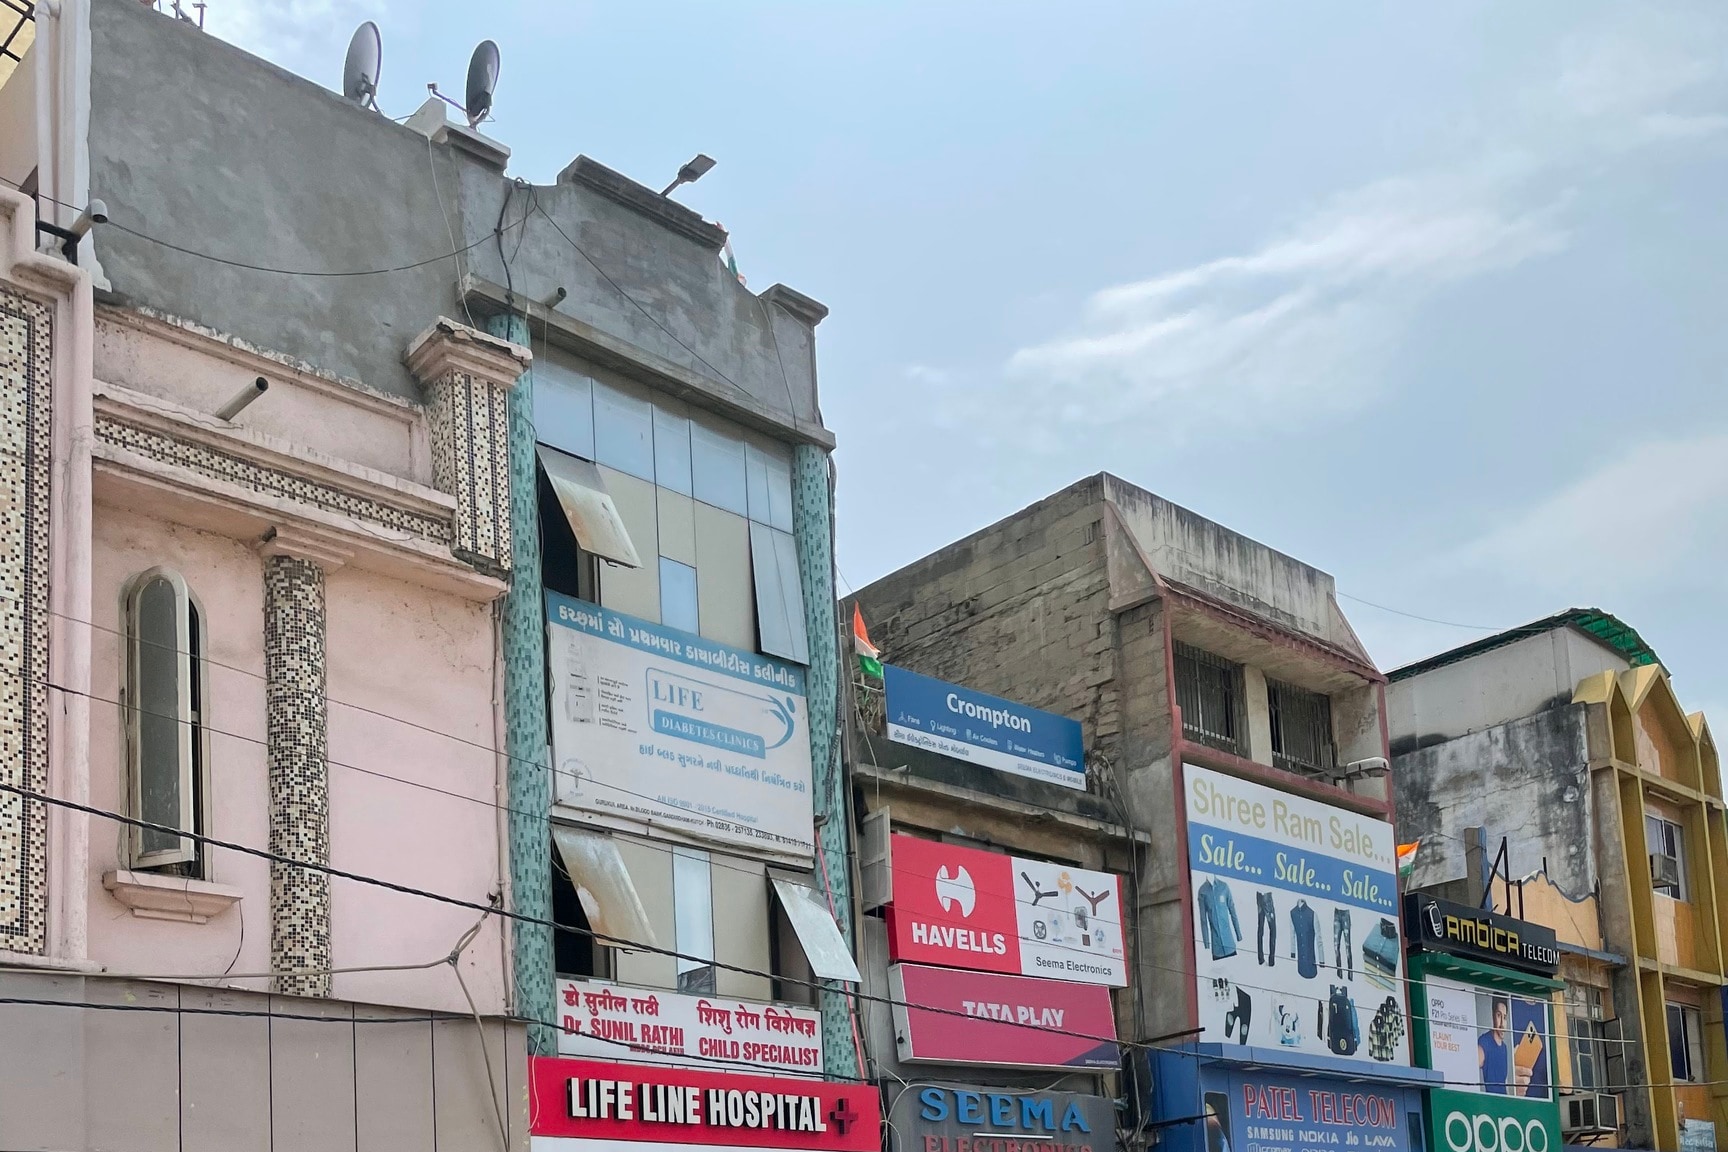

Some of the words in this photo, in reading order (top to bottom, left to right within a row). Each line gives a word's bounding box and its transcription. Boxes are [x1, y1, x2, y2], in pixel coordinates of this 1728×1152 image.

[653, 679, 704, 712] LIFE
[907, 714, 921, 725] Fans
[936, 722, 957, 736] Lighting
[946, 692, 1032, 734] Crompton
[661, 716, 716, 740] DIABETES
[717, 731, 760, 751] CLINICS
[1192, 777, 1266, 830] Shree
[1272, 798, 1323, 846] Ram
[1198, 833, 1262, 876] Sale...
[1274, 851, 1331, 892] Sale...
[1341, 869, 1393, 908] Sale...
[911, 921, 1007, 956] HAVELLS
[1521, 941, 1560, 966] TELECOM
[1035, 955, 1065, 972] Seema
[1067, 960, 1112, 977] Electronics
[583, 988, 628, 1017] सुनील
[631, 994, 660, 1017] राठी
[696, 999, 732, 1035] शिशु
[734, 1003, 761, 1031] रोग
[963, 999, 1014, 1026] TATA
[1017, 1006, 1064, 1029] PLAY
[590, 1017, 637, 1043] SUNIL
[640, 1023, 685, 1047] RATHI
[699, 1036, 740, 1060] CHILD
[743, 1041, 819, 1067] SPECIALIST
[569, 1076, 634, 1121] LIFE
[640, 1081, 701, 1125] LINE
[706, 1088, 827, 1133] HOSPITAL
[919, 1086, 1091, 1134] SEEMA
[1243, 1083, 1304, 1122] PATEL
[1308, 1089, 1397, 1130] TELECOM
[1247, 1126, 1295, 1143] SAMSUNG
[1299, 1130, 1340, 1145] NOKIA
[1364, 1134, 1397, 1148] LAVA
